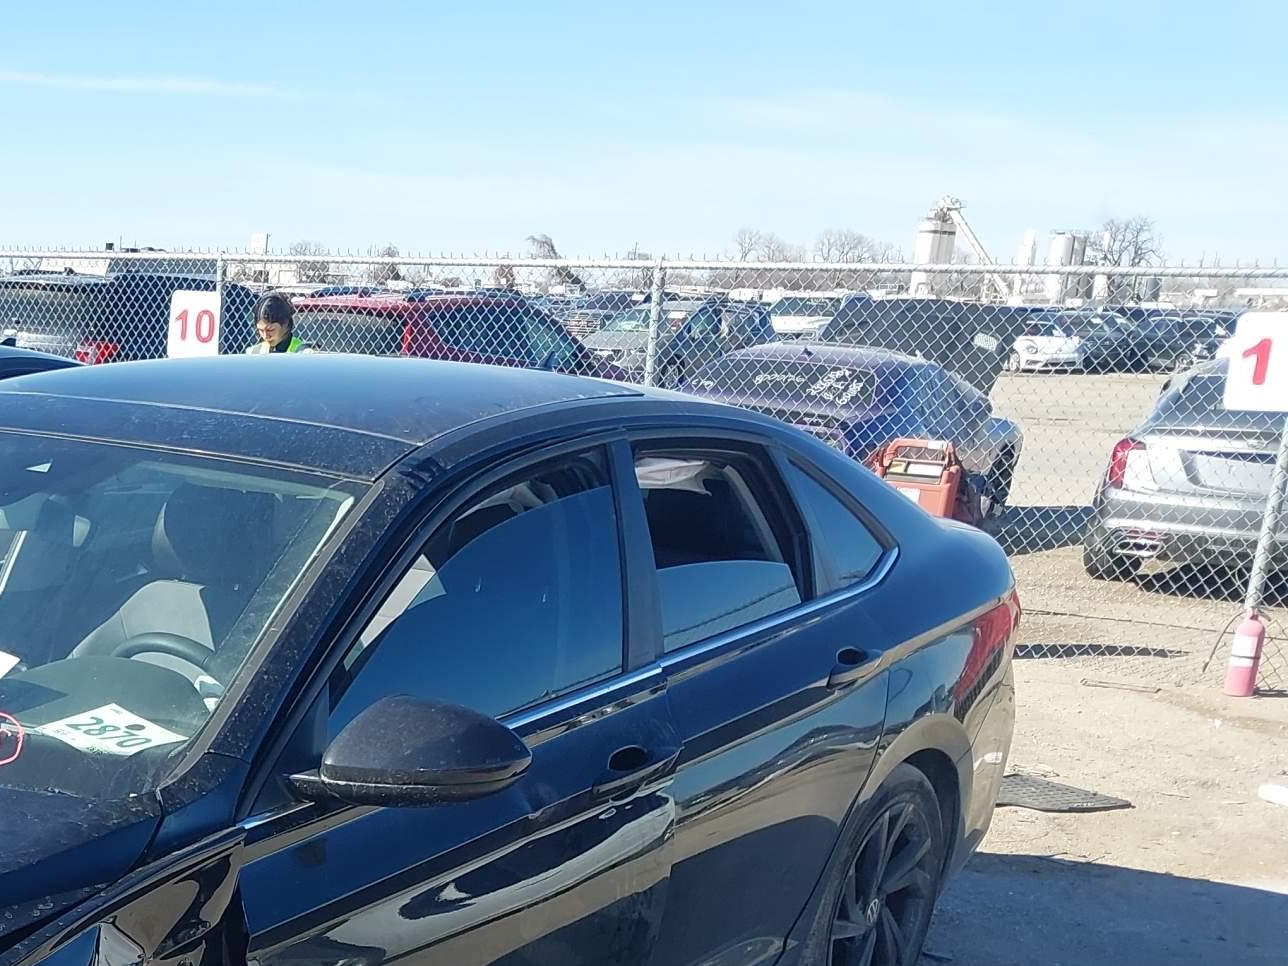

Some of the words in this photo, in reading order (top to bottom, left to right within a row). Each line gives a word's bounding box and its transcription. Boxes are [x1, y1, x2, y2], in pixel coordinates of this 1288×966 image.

[175, 309, 215, 343] 10
[1242, 338, 1273, 386] 1
[64, 716, 152, 748] 2870
